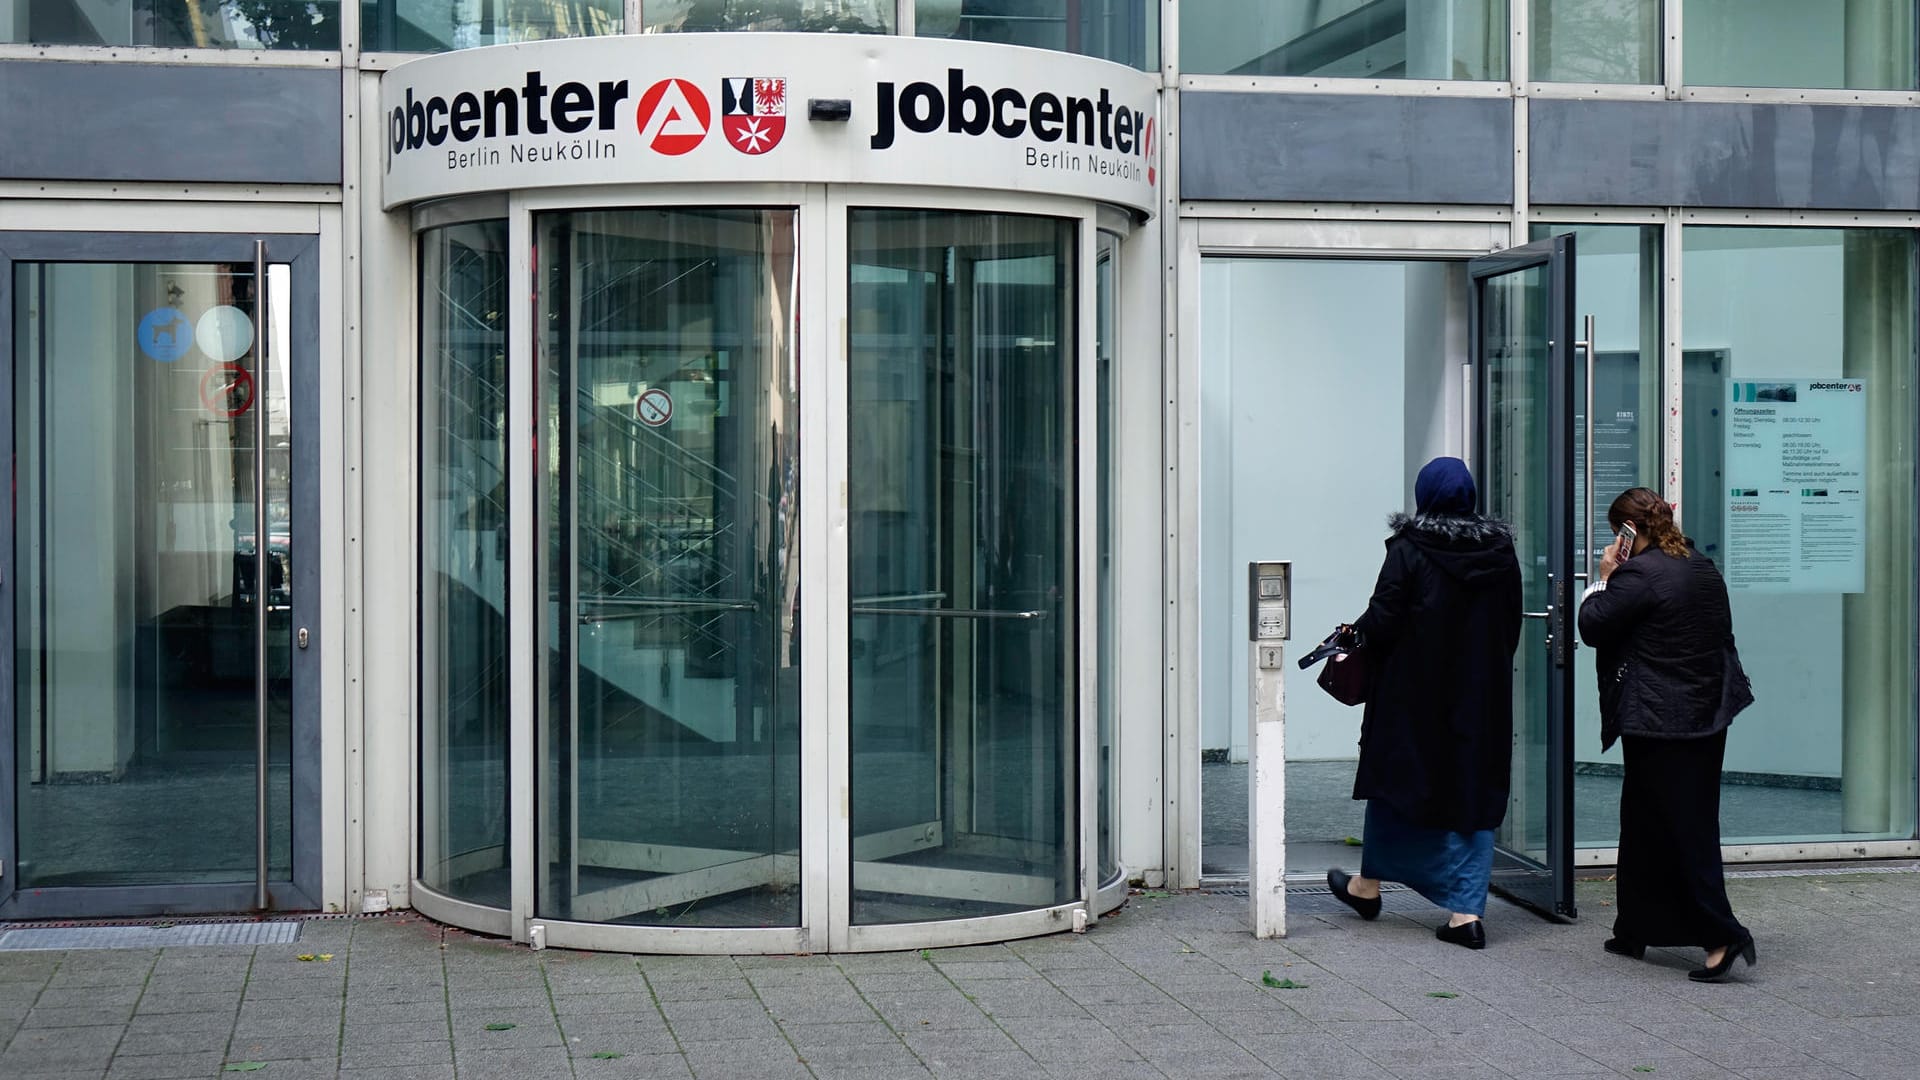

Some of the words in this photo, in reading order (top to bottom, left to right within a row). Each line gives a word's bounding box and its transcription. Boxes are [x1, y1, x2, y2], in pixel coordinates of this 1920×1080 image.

[386, 70, 629, 174] jobcenter
[870, 67, 1144, 156] jobcenter
[448, 147, 500, 170] Berlin
[510, 139, 617, 164] Neukölln
[1026, 147, 1081, 172] Berlin
[1088, 154, 1142, 182] Neukölln
[1810, 382, 1847, 391] jobcenter
[1734, 407, 1776, 415] Öffnungszeiten
